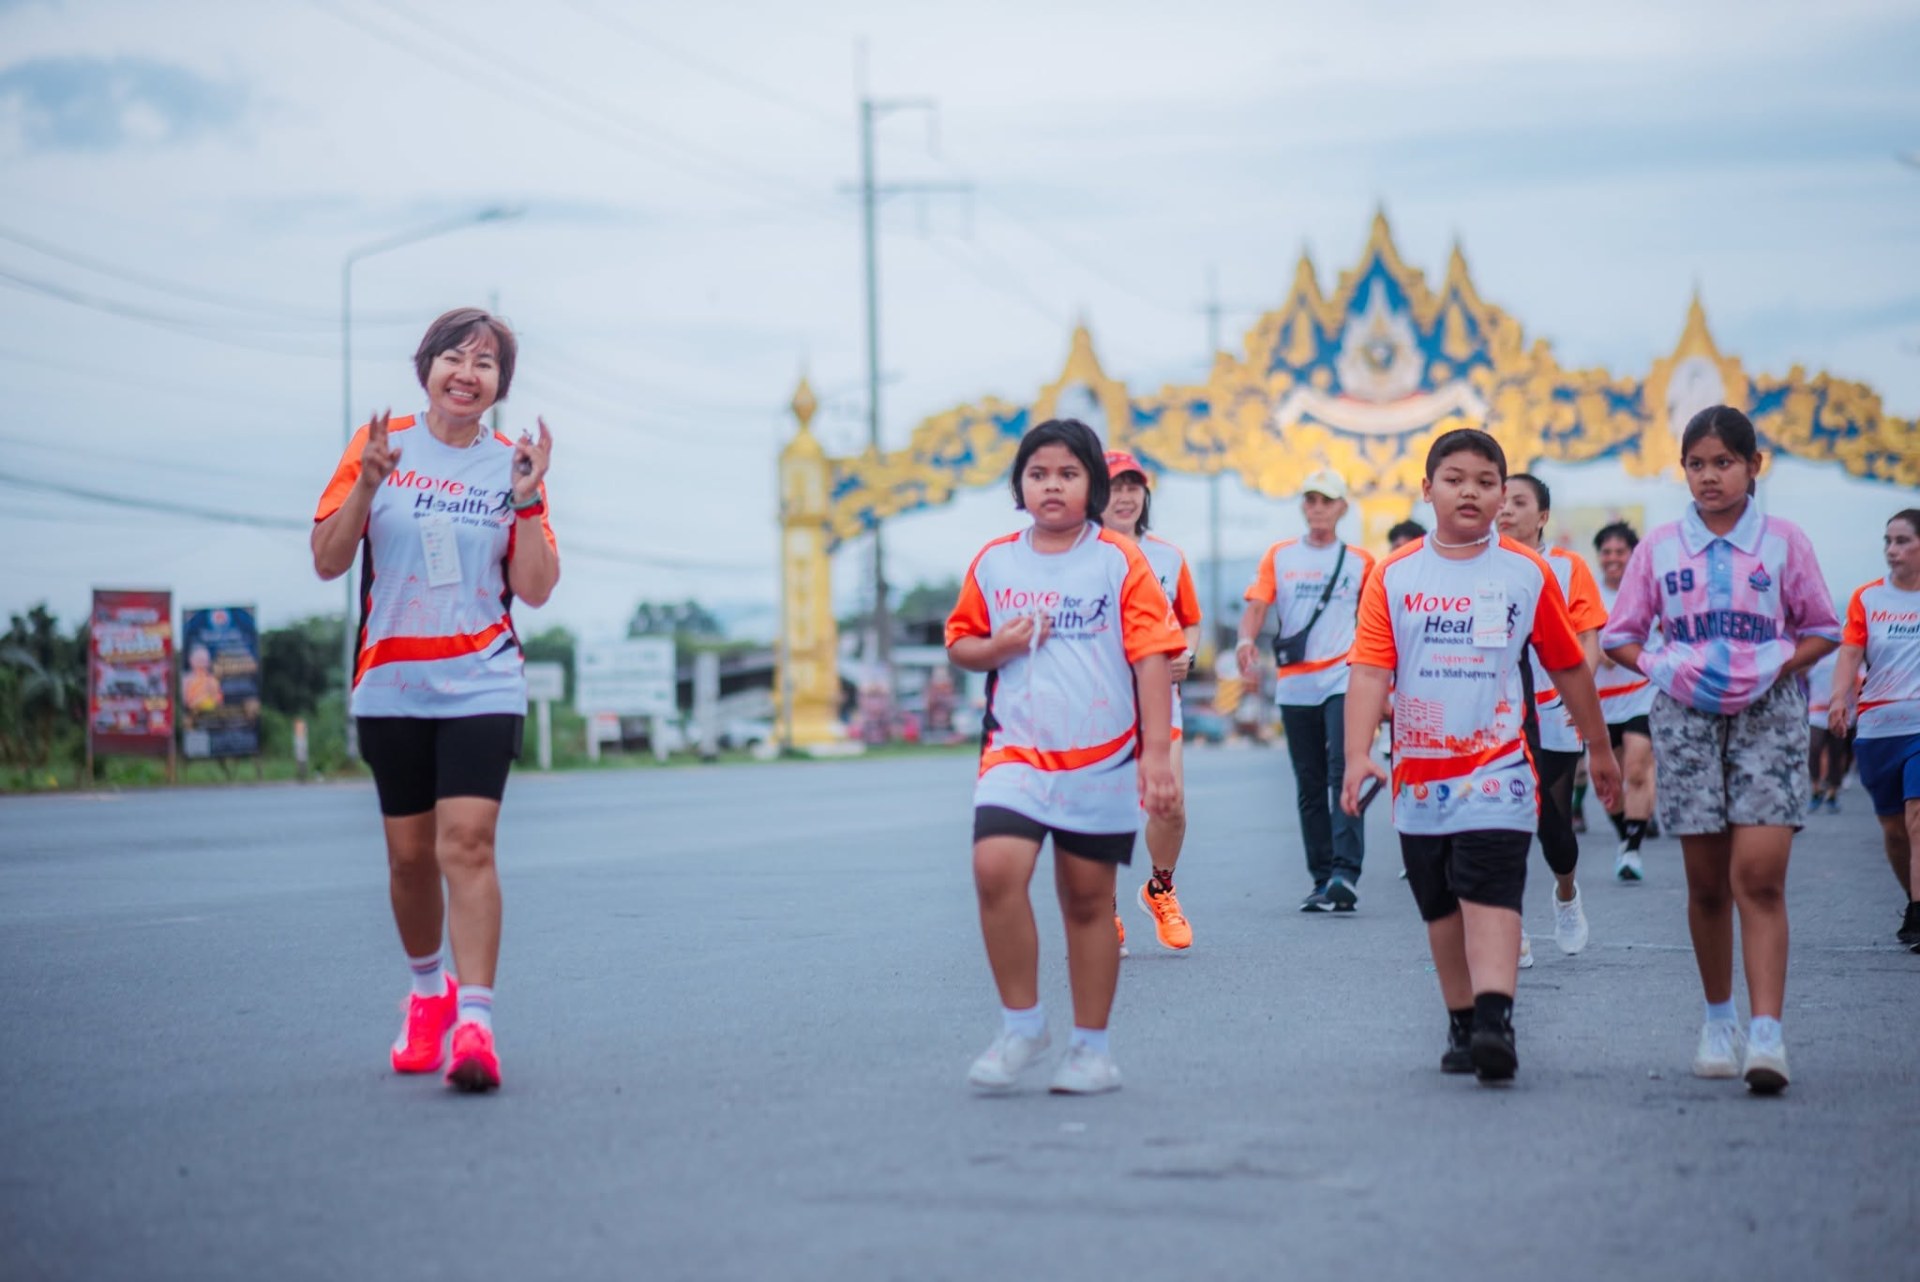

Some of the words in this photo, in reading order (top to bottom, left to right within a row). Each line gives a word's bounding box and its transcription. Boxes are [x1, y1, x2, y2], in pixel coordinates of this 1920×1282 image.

[387, 470, 465, 495] Move
[468, 486, 489, 497] for
[414, 493, 490, 516] Health
[1665, 568, 1695, 596] 69
[994, 588, 1060, 612] Move
[1063, 595, 1083, 608] for
[1404, 592, 1471, 613] Move
[1045, 611, 1084, 628] alth
[1424, 615, 1474, 634] Heal
[1870, 608, 1918, 623] Move
[1887, 622, 1920, 635] Heal
